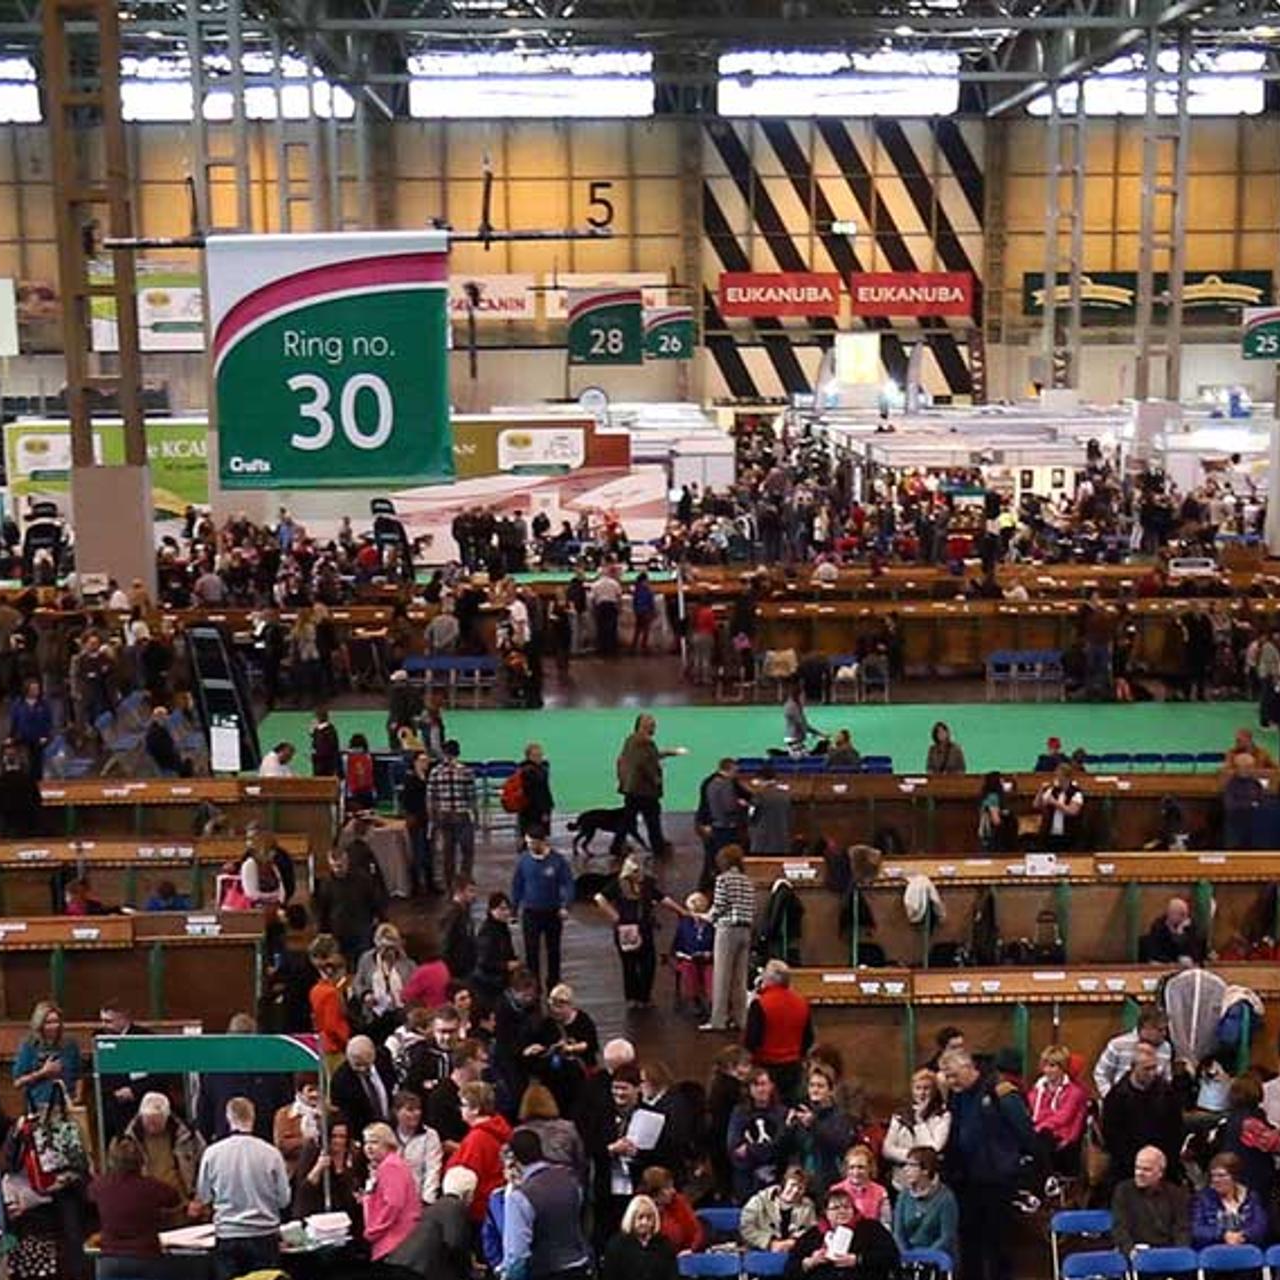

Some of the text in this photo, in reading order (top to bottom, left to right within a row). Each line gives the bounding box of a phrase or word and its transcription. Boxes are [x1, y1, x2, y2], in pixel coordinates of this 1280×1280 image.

[587, 182, 615, 228] 5
[726, 286, 833, 303] EUKANUBA
[857, 286, 965, 303] EUKANUBA
[283, 330, 396, 364] Ring no.
[589, 329, 624, 354] 28
[658, 335, 682, 353] 26
[1255, 335, 1279, 352] 25
[285, 372, 395, 451] 30
